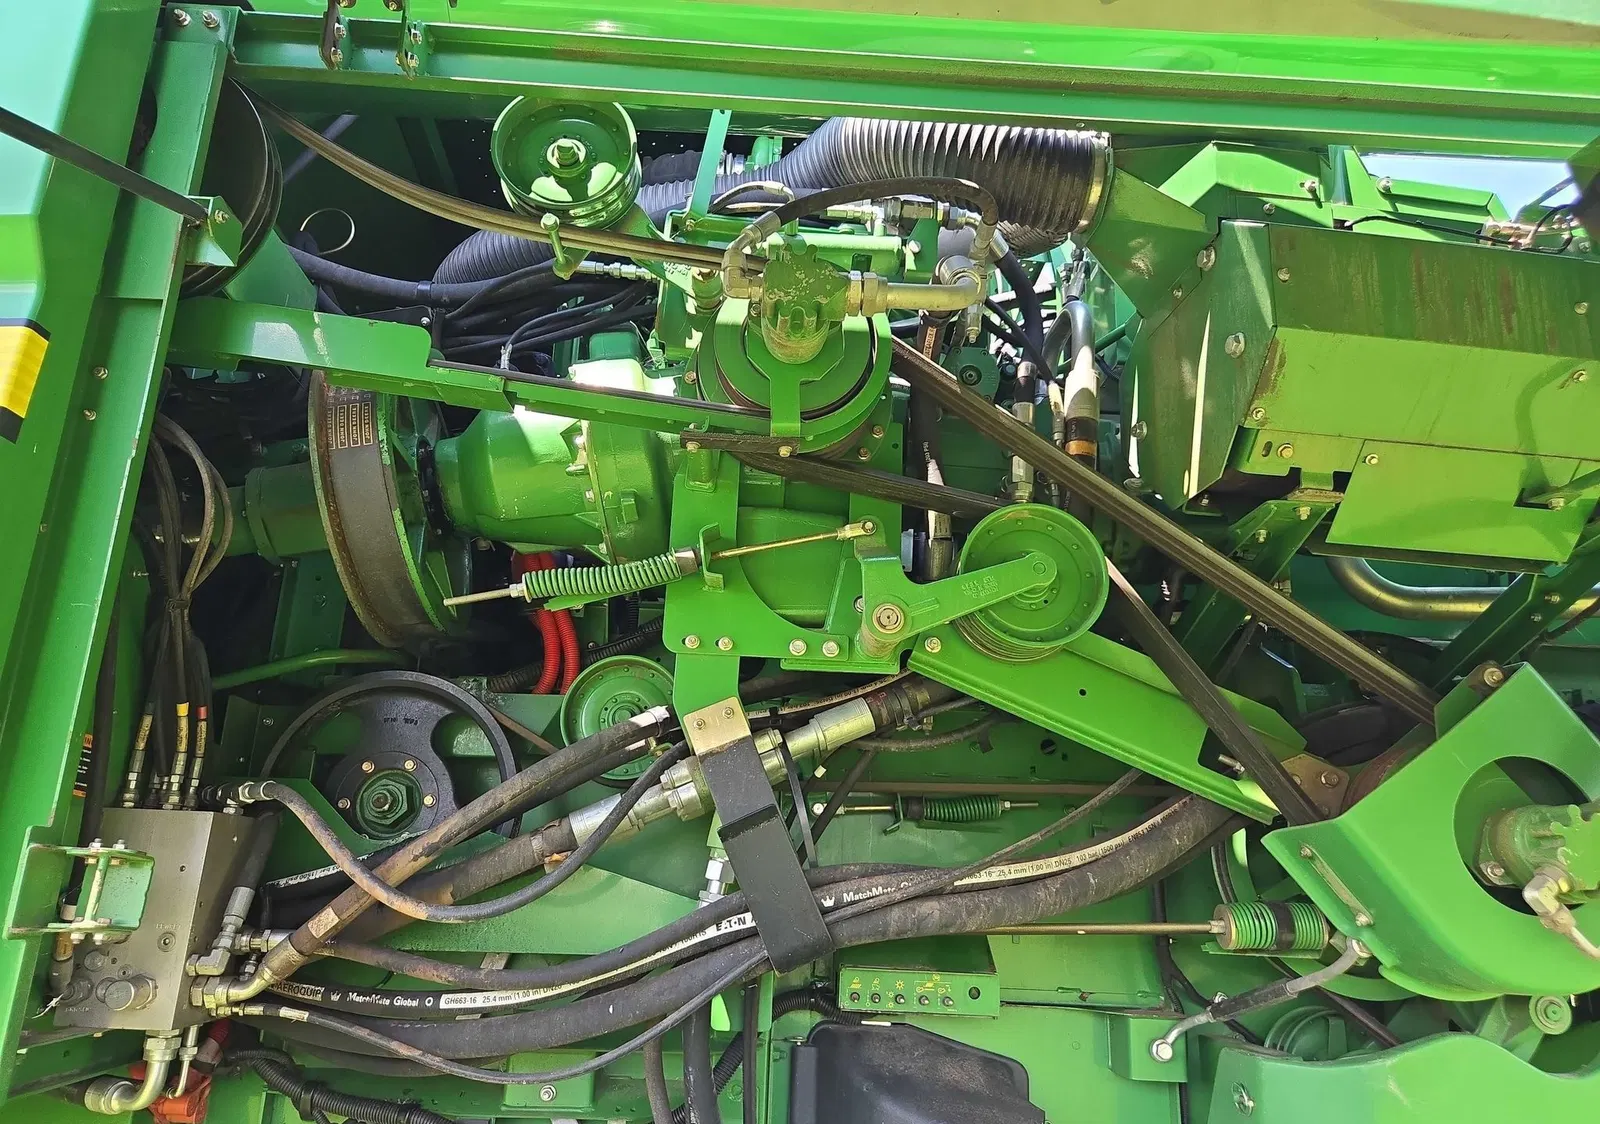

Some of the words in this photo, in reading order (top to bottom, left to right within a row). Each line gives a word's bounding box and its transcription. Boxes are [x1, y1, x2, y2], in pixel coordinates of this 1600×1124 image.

[997, 868, 1012, 877] 25.4
[1013, 867, 1027, 875] mm
[1055, 857, 1072, 868] DN25
[394, 997, 419, 1007] Global
[482, 995, 497, 1004] 25.4
[513, 990, 531, 1000] (1.00
